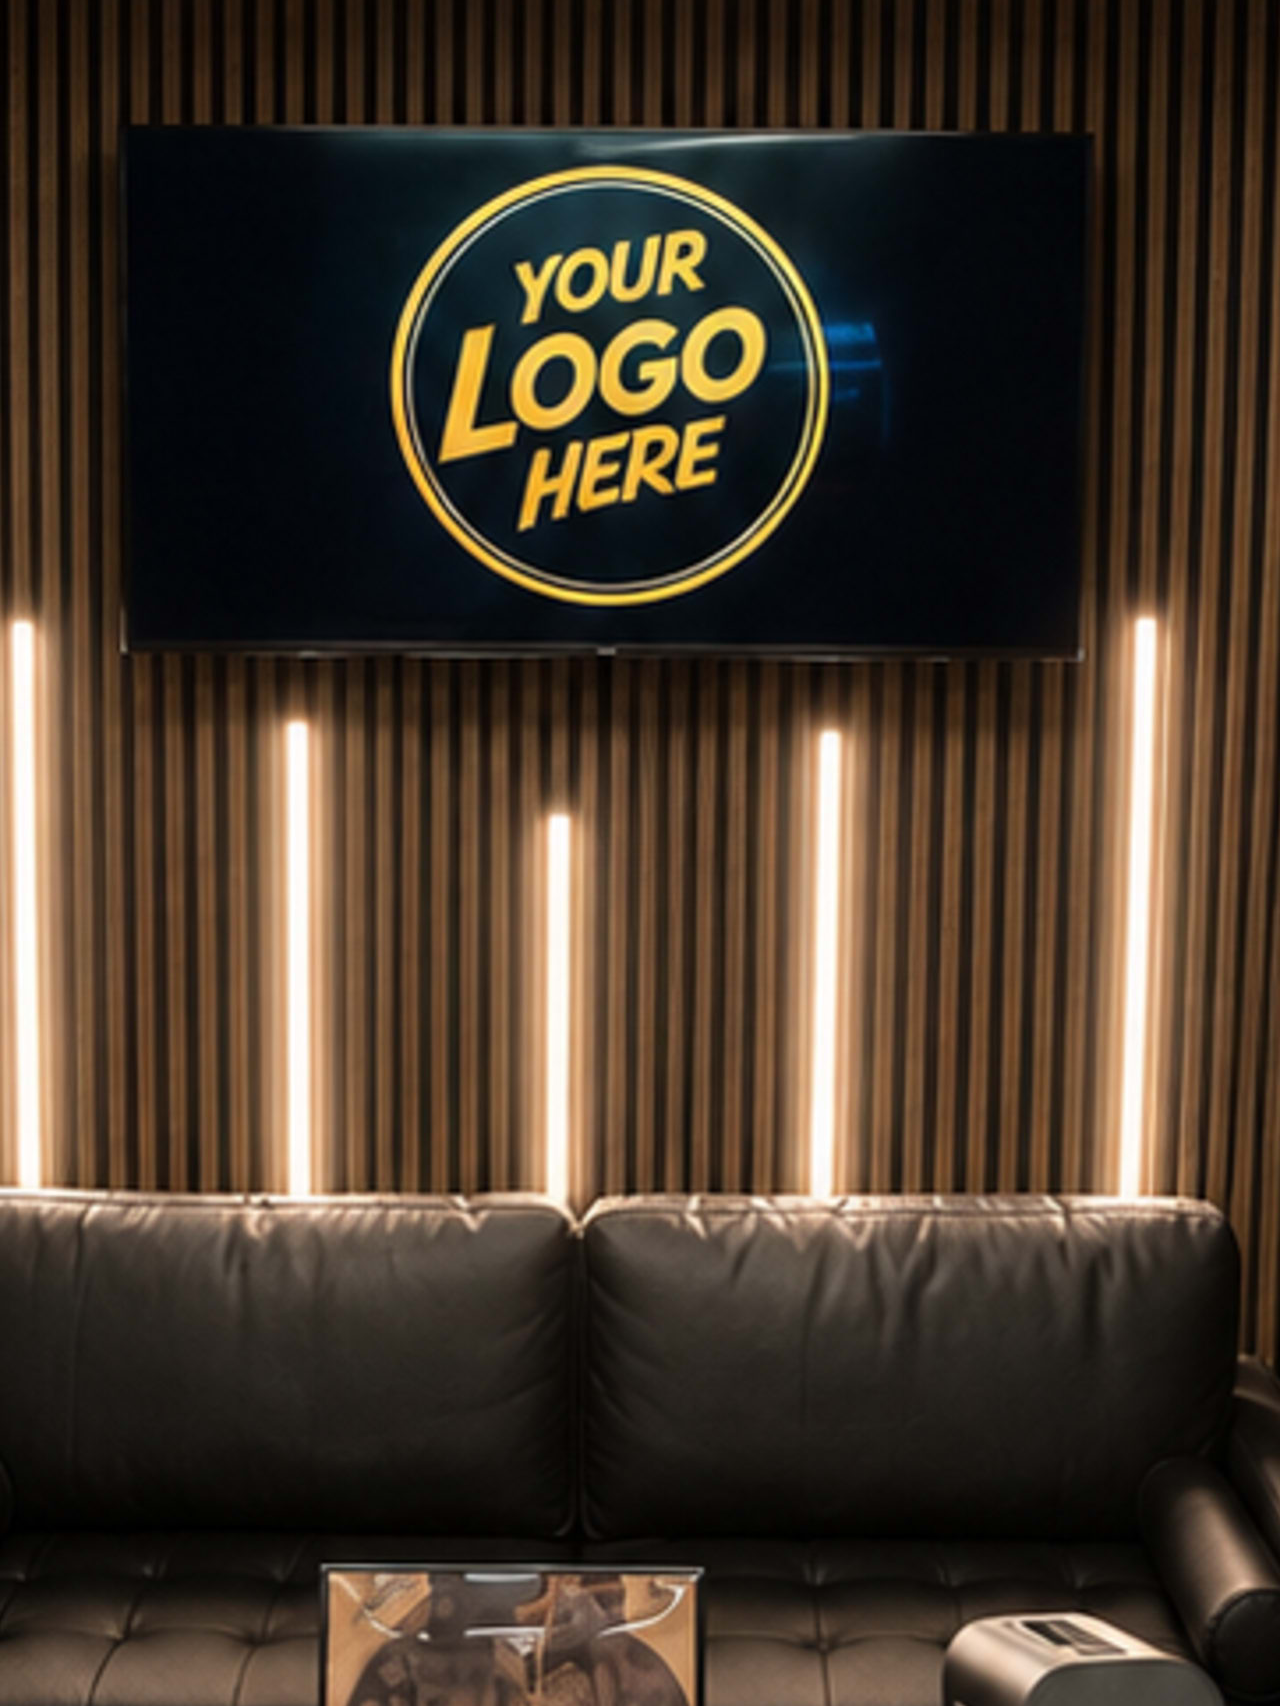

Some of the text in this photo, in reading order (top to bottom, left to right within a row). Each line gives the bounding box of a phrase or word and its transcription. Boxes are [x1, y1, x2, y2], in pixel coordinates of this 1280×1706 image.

[514, 229, 707, 325] YOUR
[438, 306, 766, 463] LOGO
[517, 415, 726, 532] HERE
